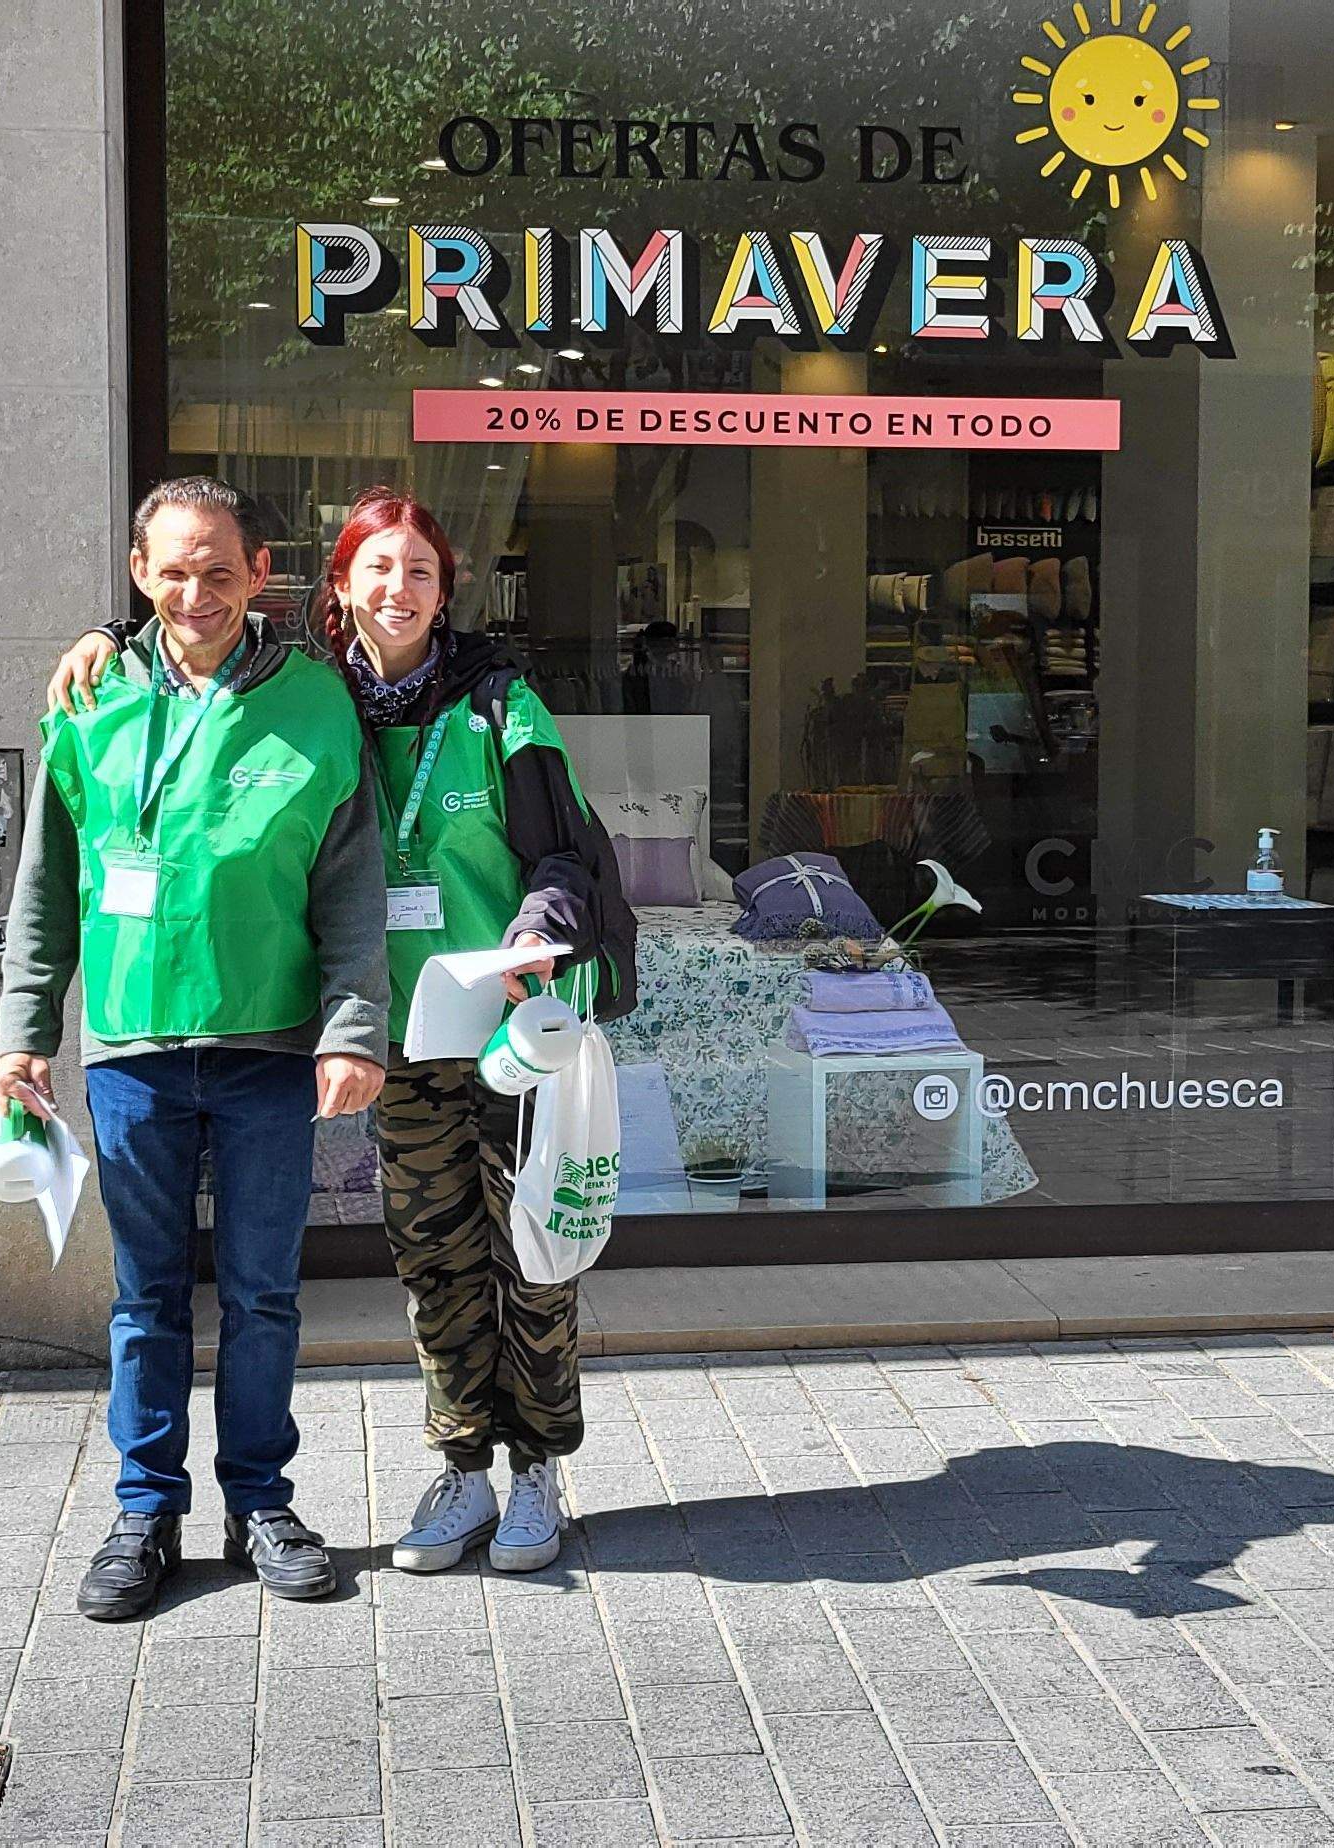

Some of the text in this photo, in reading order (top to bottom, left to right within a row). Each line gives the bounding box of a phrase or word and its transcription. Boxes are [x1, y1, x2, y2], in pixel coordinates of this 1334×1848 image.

[439, 115, 967, 184] OFERTAS DE
[295, 222, 1236, 358] PRIMAVERA
[486, 406, 1052, 438] 20% DE DESCUENTO EN TODO
[977, 526, 1062, 547] bassetti
[1033, 906, 1107, 921] MODA
[975, 1072, 1283, 1118] @cmchuesca
